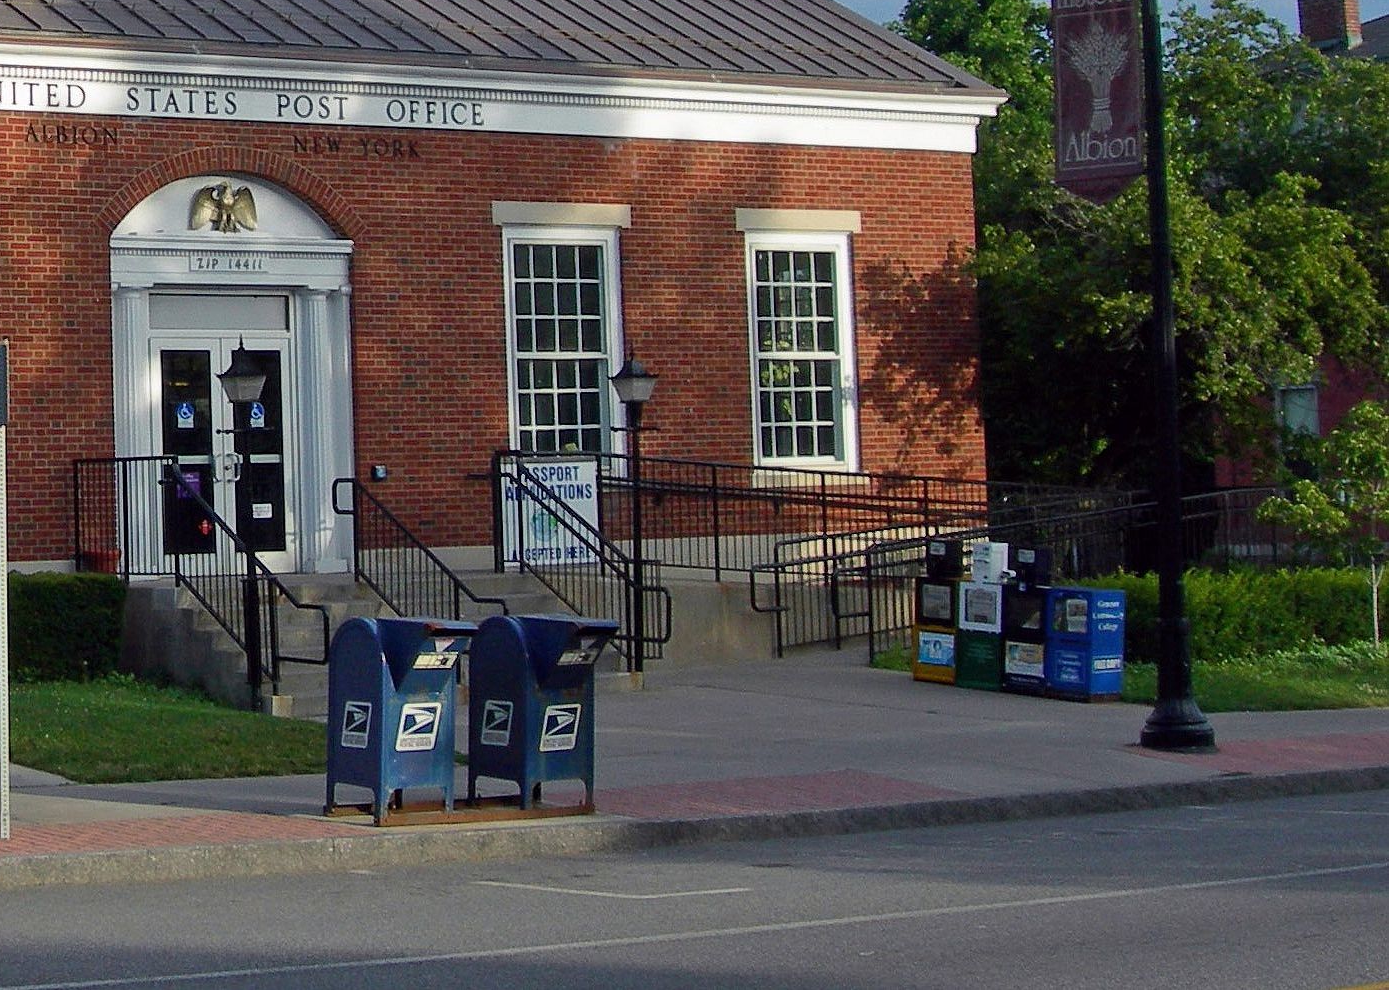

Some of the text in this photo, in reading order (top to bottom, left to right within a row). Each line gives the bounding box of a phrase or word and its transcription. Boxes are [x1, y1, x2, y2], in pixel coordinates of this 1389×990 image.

[126, 87, 237, 115] STATES
[276, 94, 348, 120] POST
[386, 99, 484, 126] OFFICE
[24, 124, 118, 145] ALBION
[1066, 131, 1137, 161] Albion
[293, 135, 421, 158] NEW YORK
[196, 257, 262, 270] ZIP 14411
